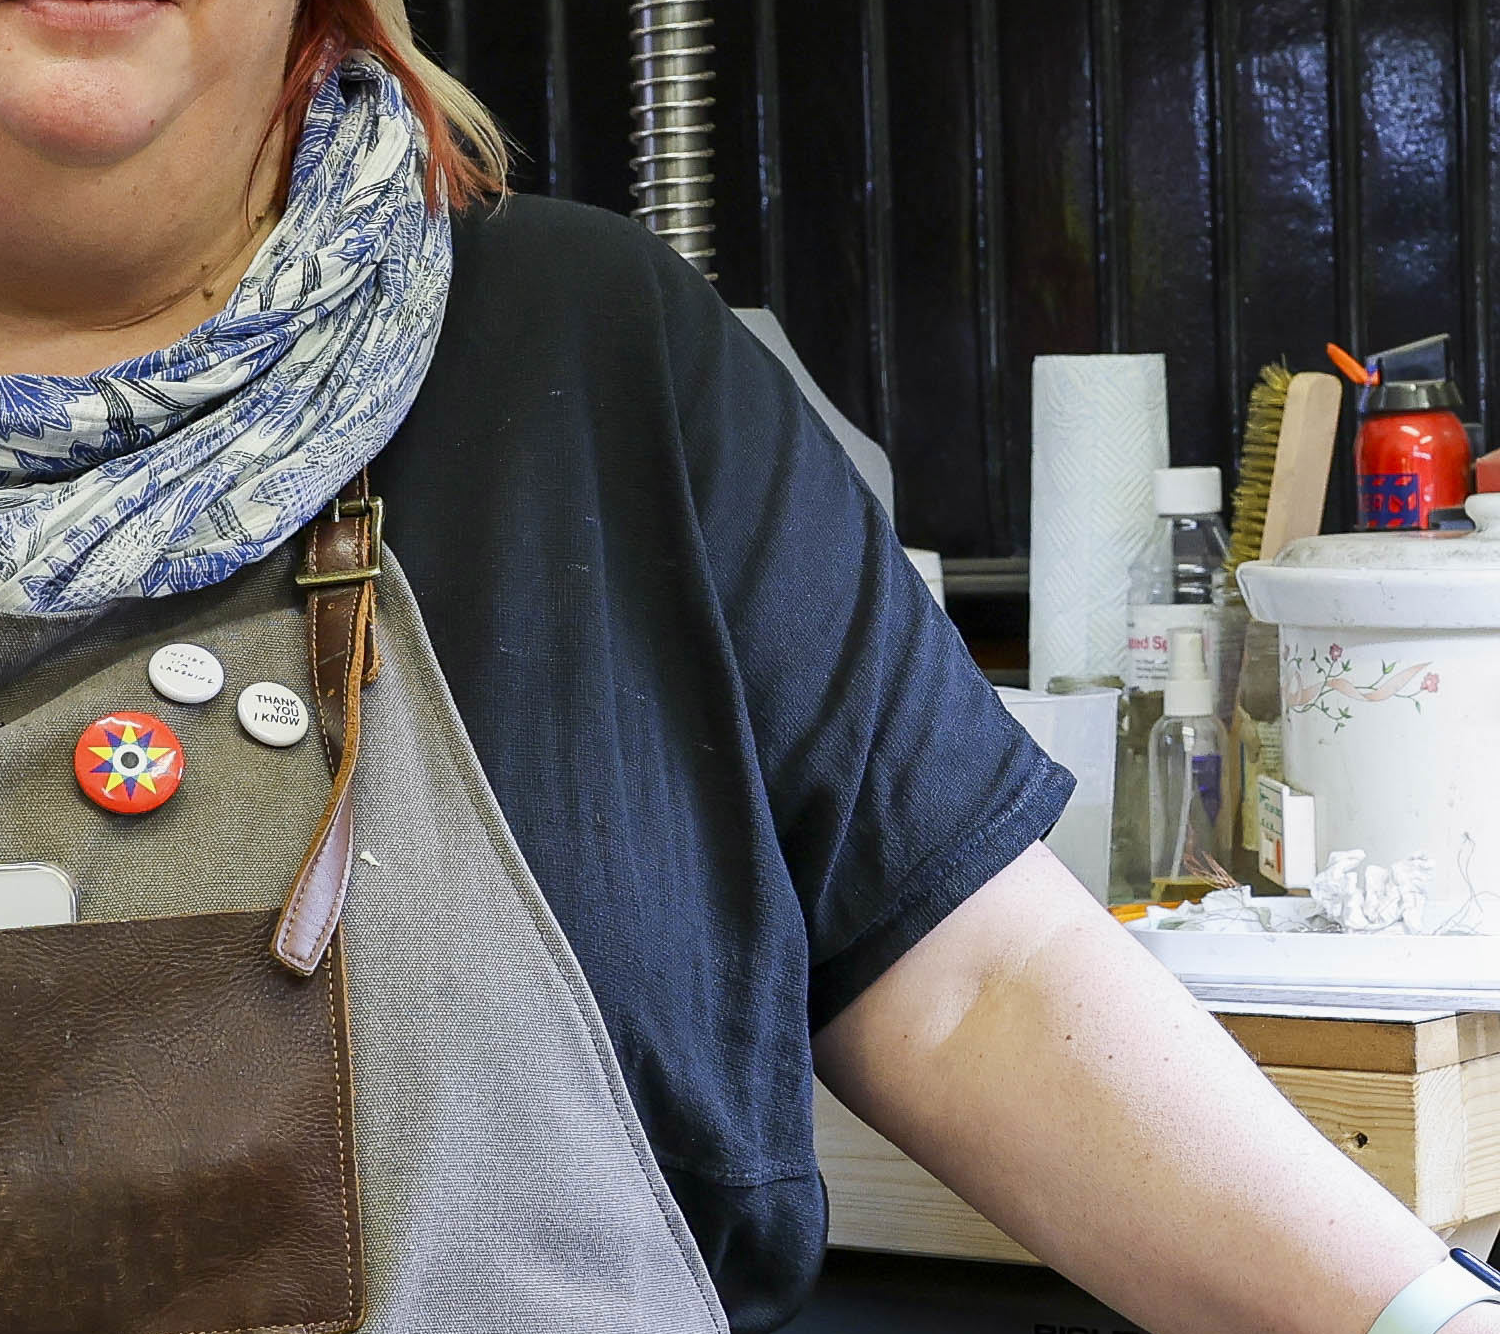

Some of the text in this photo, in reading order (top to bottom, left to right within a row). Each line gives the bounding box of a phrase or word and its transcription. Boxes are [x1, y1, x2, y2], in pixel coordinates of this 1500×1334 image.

[255, 693, 299, 709] THANK
[273, 704, 300, 717] YOU
[261, 713, 301, 727] KNOW
